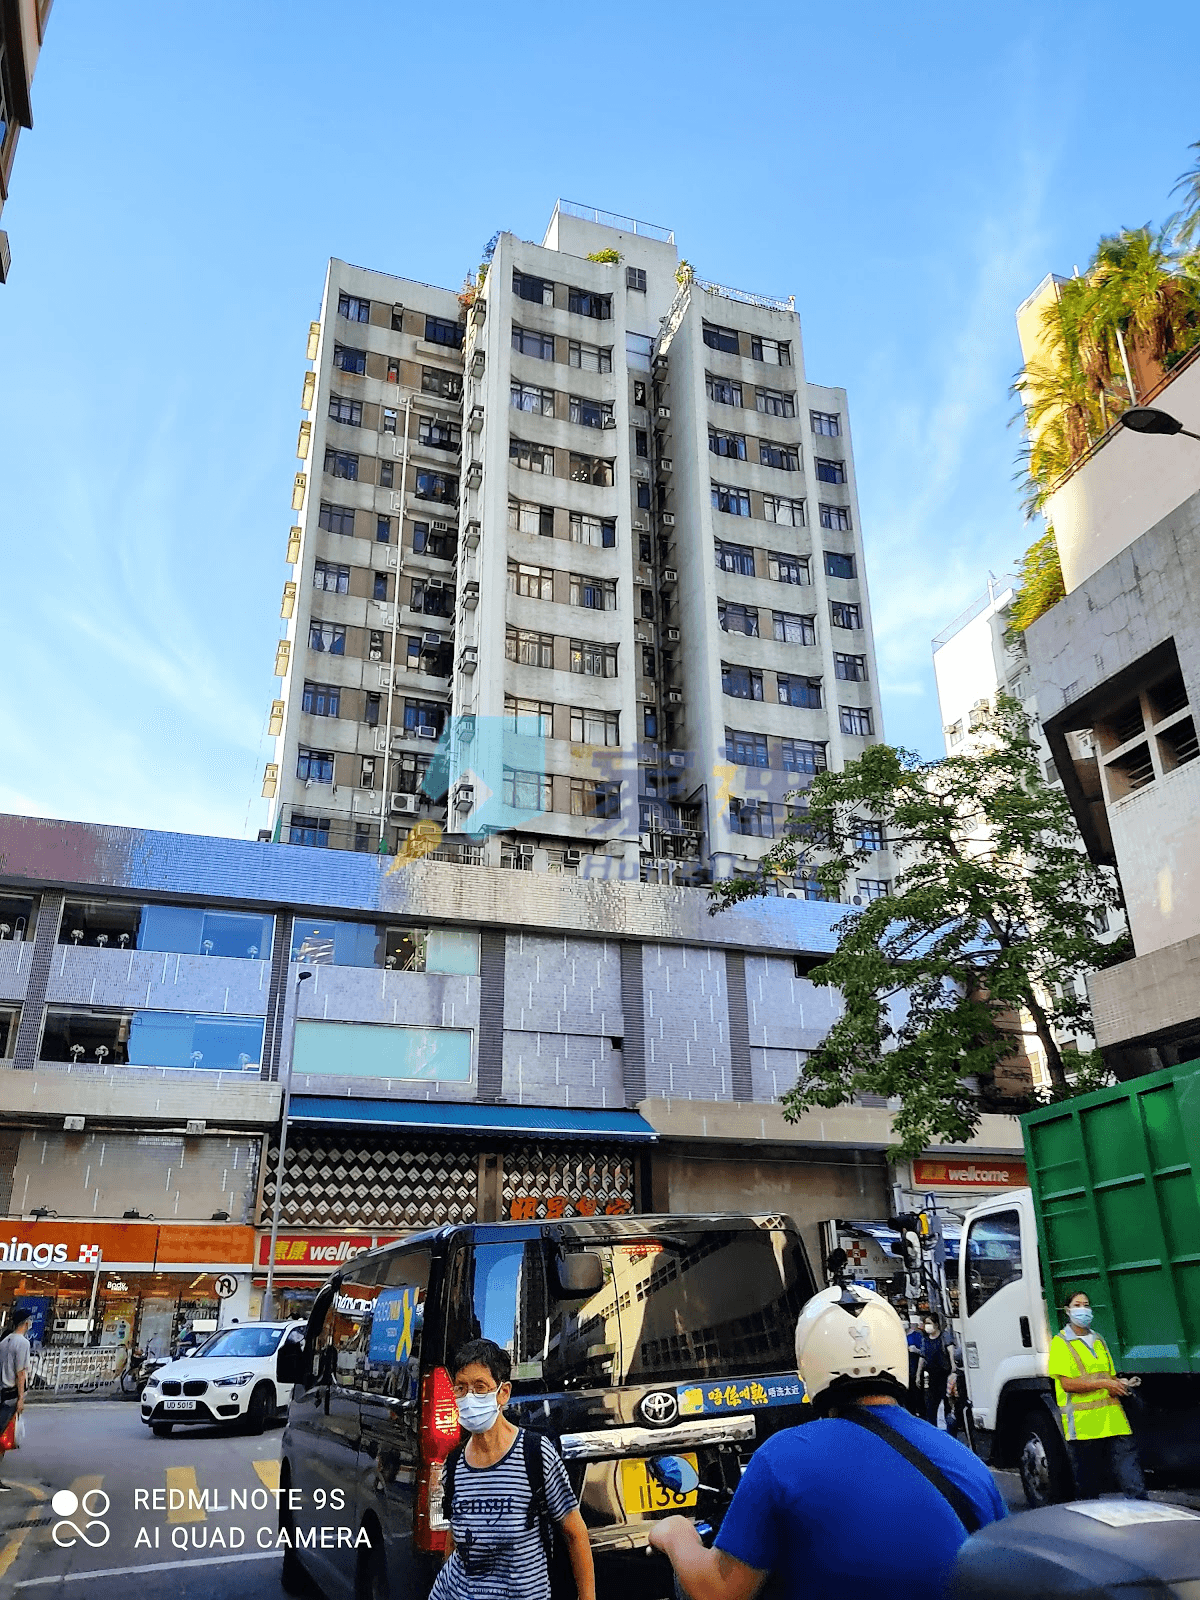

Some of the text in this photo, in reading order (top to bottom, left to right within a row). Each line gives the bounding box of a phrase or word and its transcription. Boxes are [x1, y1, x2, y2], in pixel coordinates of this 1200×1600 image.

[948, 1165, 1009, 1182] wellcome
[310, 1241, 370, 1261] wellco
[166, 1401, 194, 1409] UD 5015
